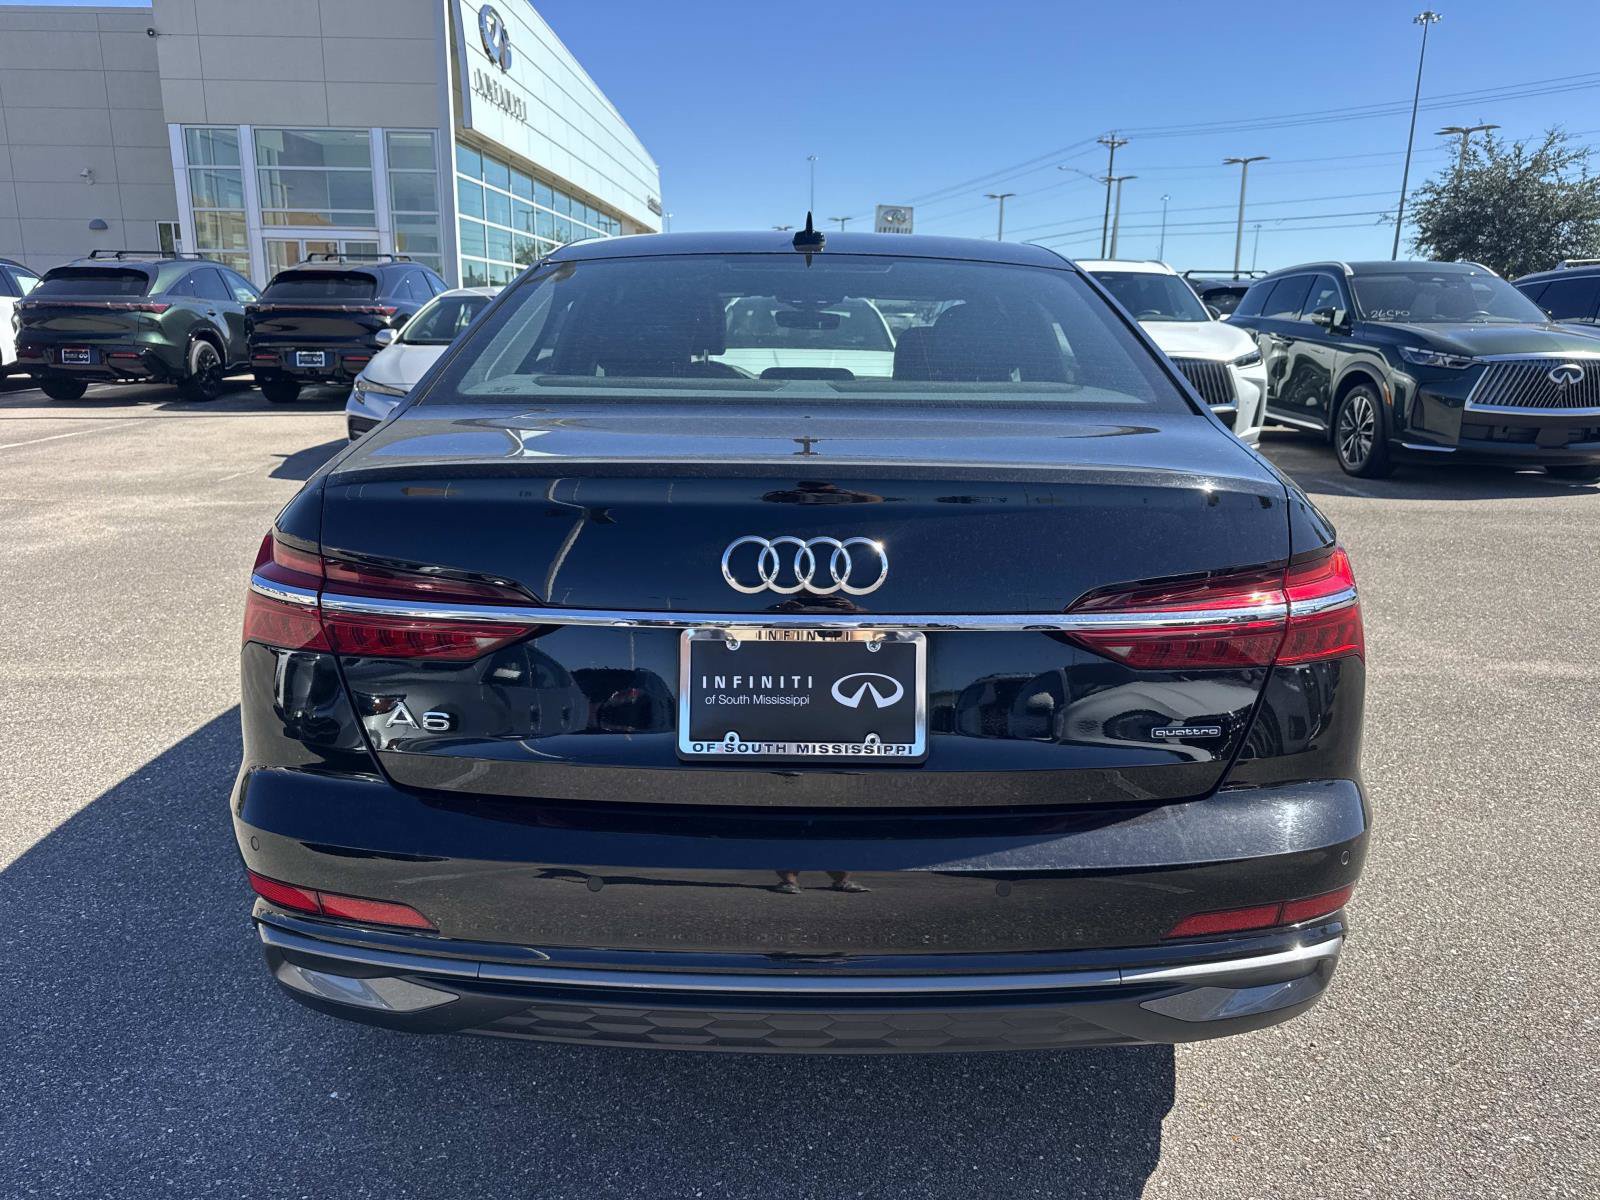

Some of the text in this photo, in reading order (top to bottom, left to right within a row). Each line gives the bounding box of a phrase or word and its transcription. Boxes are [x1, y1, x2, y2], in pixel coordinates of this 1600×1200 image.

[702, 675, 813, 689] INFINITI
[705, 694, 810, 707] of South Mississippi
[385, 701, 451, 731] A6
[1155, 728, 1218, 737] quattro
[692, 743, 913, 756] OF SOUTH MISSISSIPPI
